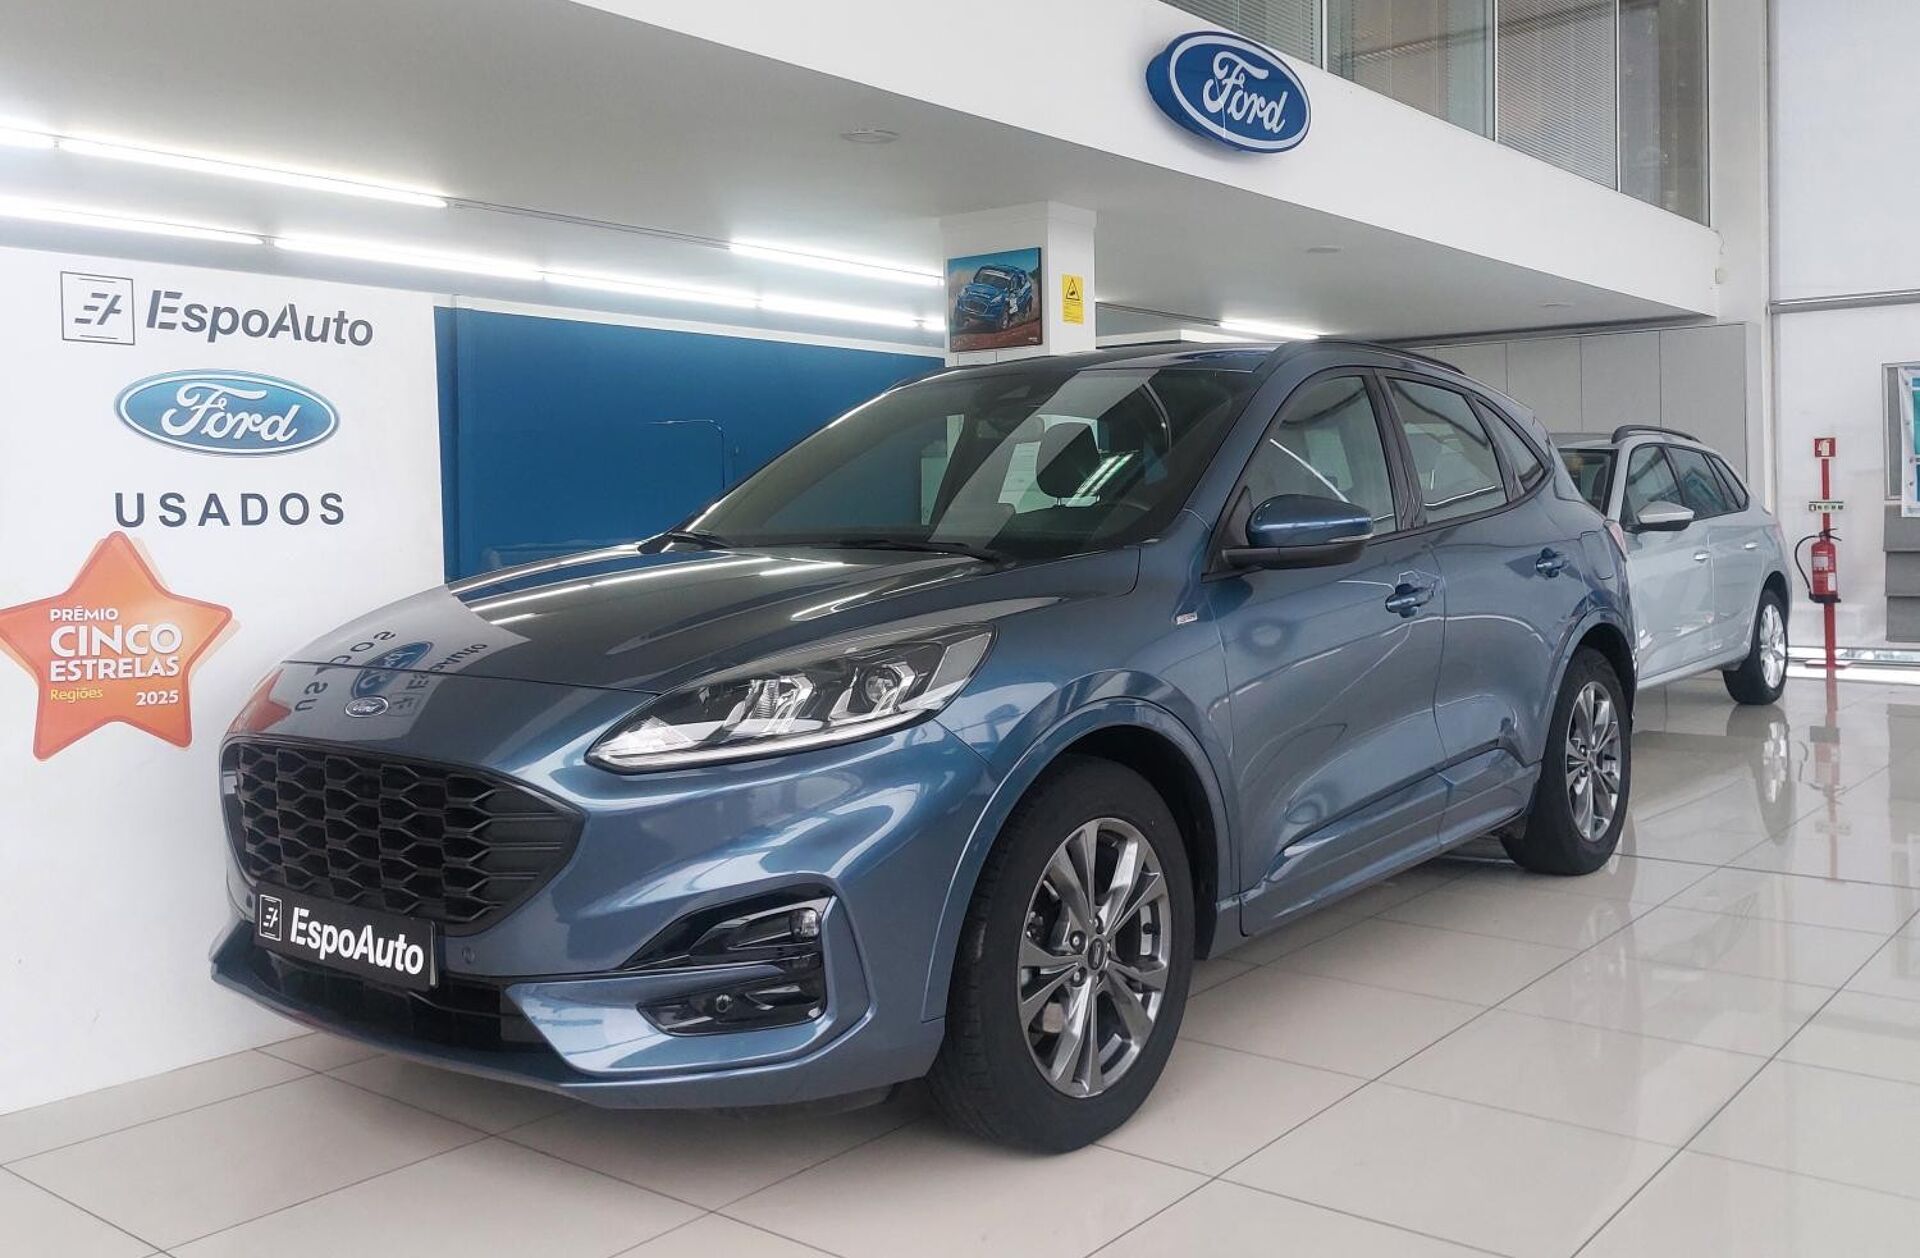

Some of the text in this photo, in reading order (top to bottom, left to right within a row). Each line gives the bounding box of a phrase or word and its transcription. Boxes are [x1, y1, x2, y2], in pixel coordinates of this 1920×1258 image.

[1202, 51, 1289, 133] Ford
[145, 289, 374, 346] EspoAuto
[162, 382, 301, 443] Ford
[114, 492, 345, 528] USADOS
[50, 605, 119, 622] PRÉMIO
[50, 622, 183, 658] CINCO
[50, 655, 180, 682] ESTRELAS
[50, 687, 179, 706] Regiões 2025
[290, 906, 425, 975] EspoAuto
